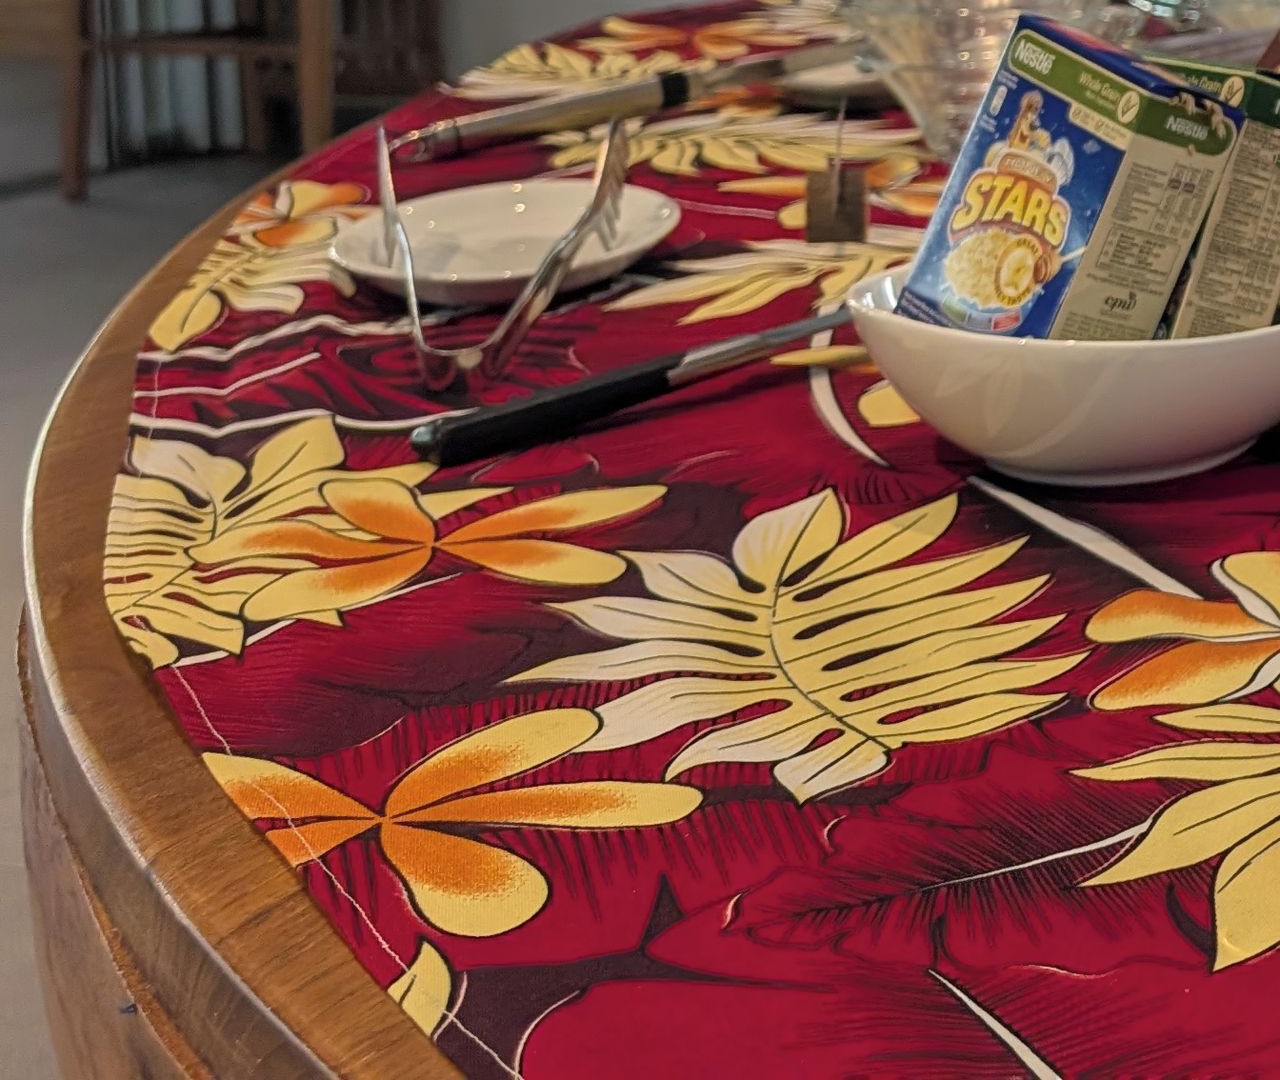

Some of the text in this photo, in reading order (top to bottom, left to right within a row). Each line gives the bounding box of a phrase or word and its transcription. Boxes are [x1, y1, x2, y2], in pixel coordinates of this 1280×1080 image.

[1015, 38, 1056, 75] Nestlé
[1079, 72, 1102, 91] Whole
[951, 173, 1068, 246] STARS
